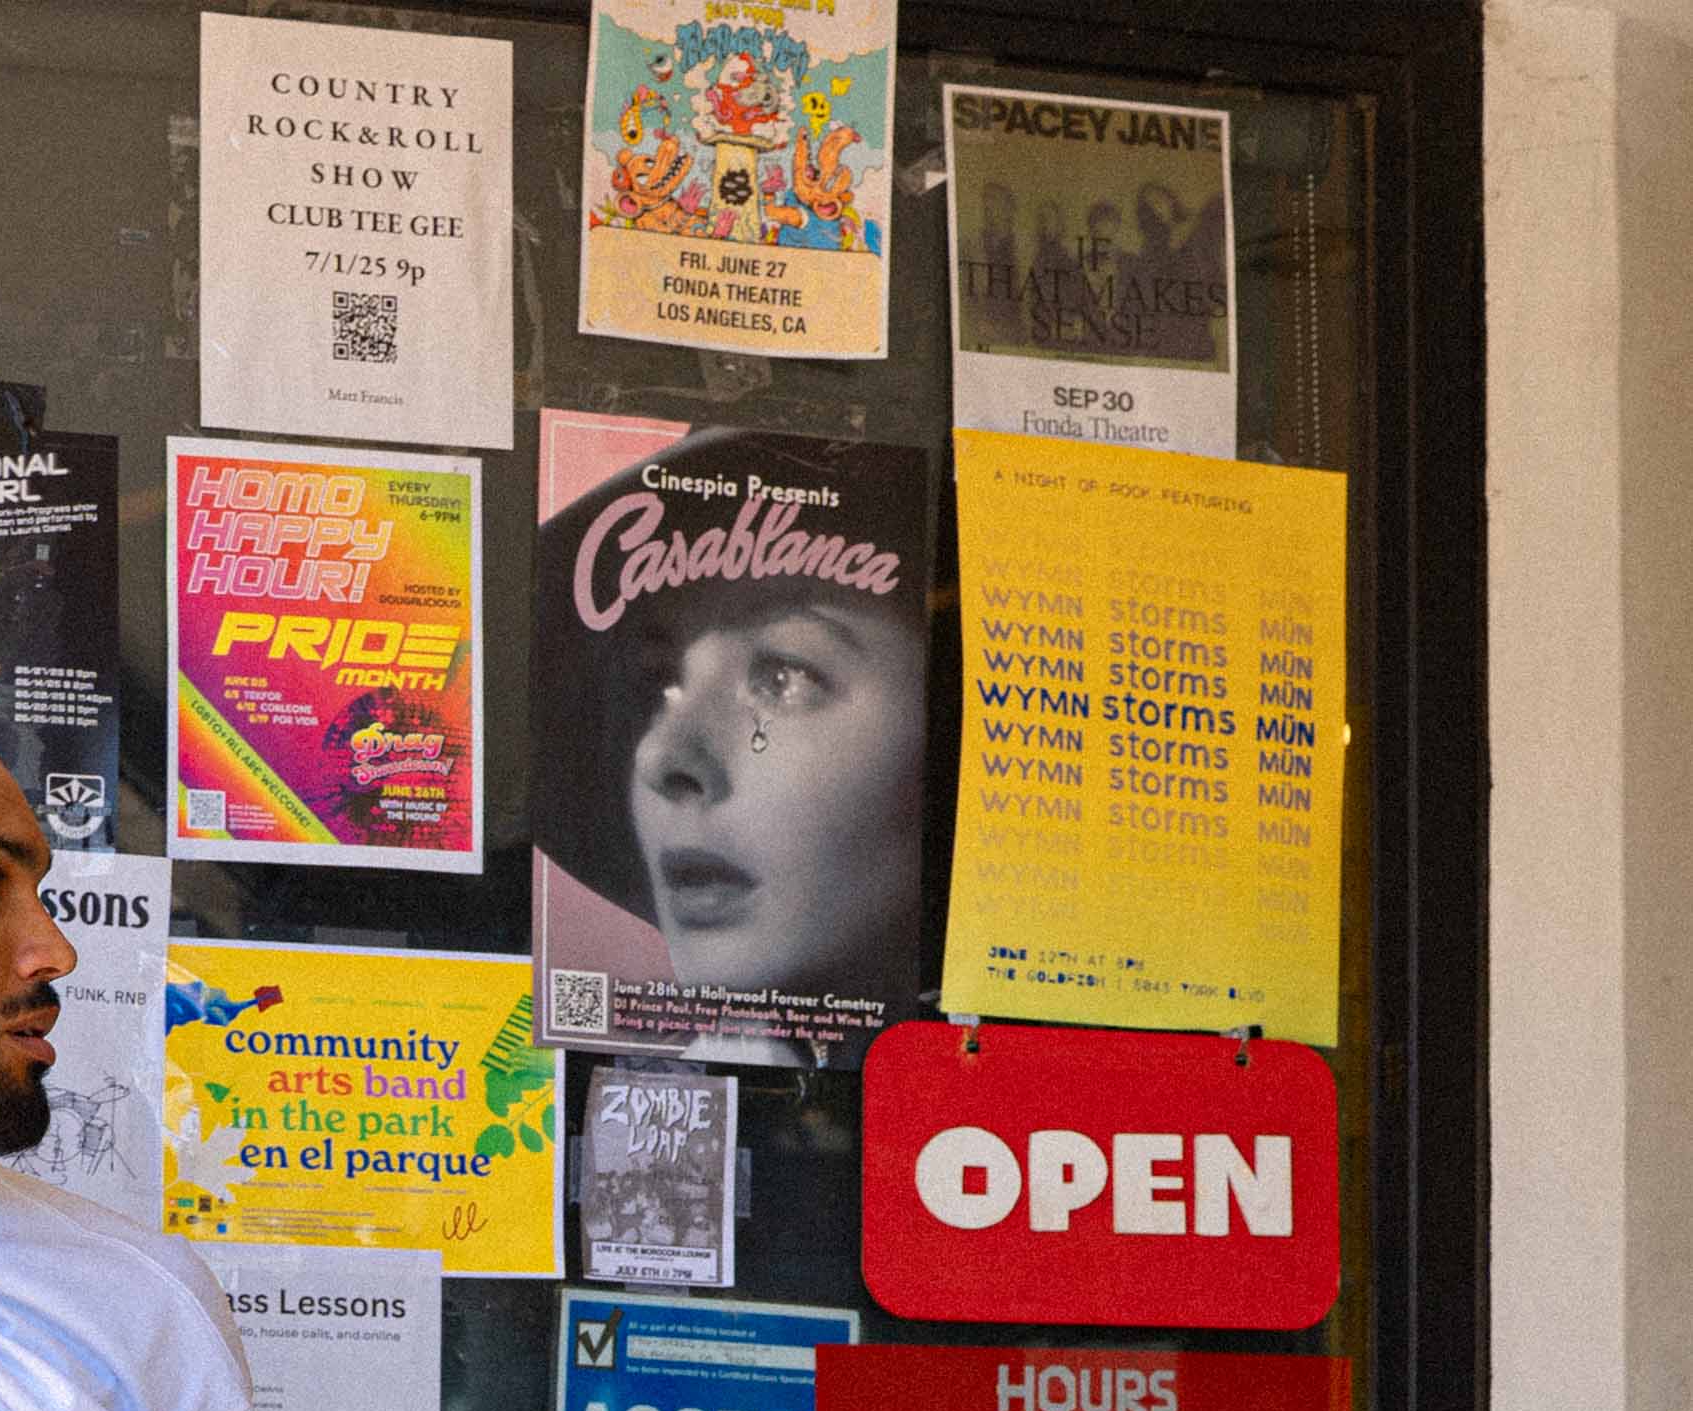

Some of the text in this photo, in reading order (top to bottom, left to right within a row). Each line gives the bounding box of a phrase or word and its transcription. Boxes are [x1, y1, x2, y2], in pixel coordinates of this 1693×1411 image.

[271, 73, 458, 108] COUNTRY
[248, 114, 482, 154] ROCK&ROLL
[952, 94, 1223, 153] SPACEY JANE
[311, 162, 418, 190] SHOW
[267, 203, 464, 239] CLUB TEE GEE
[305, 251, 425, 286] 7/1/25 9p
[680, 251, 787, 279] FRI. JUNE 27
[1077, 236, 1112, 270] IF
[663, 276, 802, 307] FONDA THEATRE
[961, 260, 1227, 319] THAT MAKES
[658, 302, 806, 334] LOS ANGELES, CA
[1029, 311, 1157, 348] SENSE
[1053, 386, 1134, 412] SEP 30
[1023, 410, 1169, 443] Fonda Theatre
[186, 466, 365, 516] HOMO
[389, 481, 431, 493] EVERY
[641, 463, 840, 508] Cinespia Presents
[420, 510, 461, 523] 6-9PM
[186, 511, 393, 562] HAPPY
[186, 554, 370, 604] HOUR!
[573, 491, 900, 632] Casablanca
[212, 610, 461, 671] PRIDE
[335, 668, 448, 692] MONTH
[977, 680, 1315, 748] WYMN storms MÜN
[351, 722, 444, 762] Drag
[982, 718, 1312, 779] WYMN storms MÜN
[381, 784, 446, 798] JUNE 26TH
[66, 985, 147, 1005] FUNK, RNB
[614, 979, 886, 1015] June 28th at Hollywood Forever Cemetery
[225, 1029, 460, 1070] community
[268, 1064, 467, 1101] arts band
[231, 1097, 454, 1141] in the park
[601, 1085, 712, 1131] ZOMBIE
[240, 1138, 491, 1182] en el parque
[916, 1126, 1292, 1237] OPEN
[280, 1289, 406, 1319] Lessons
[337, 1329, 401, 1342] and online
